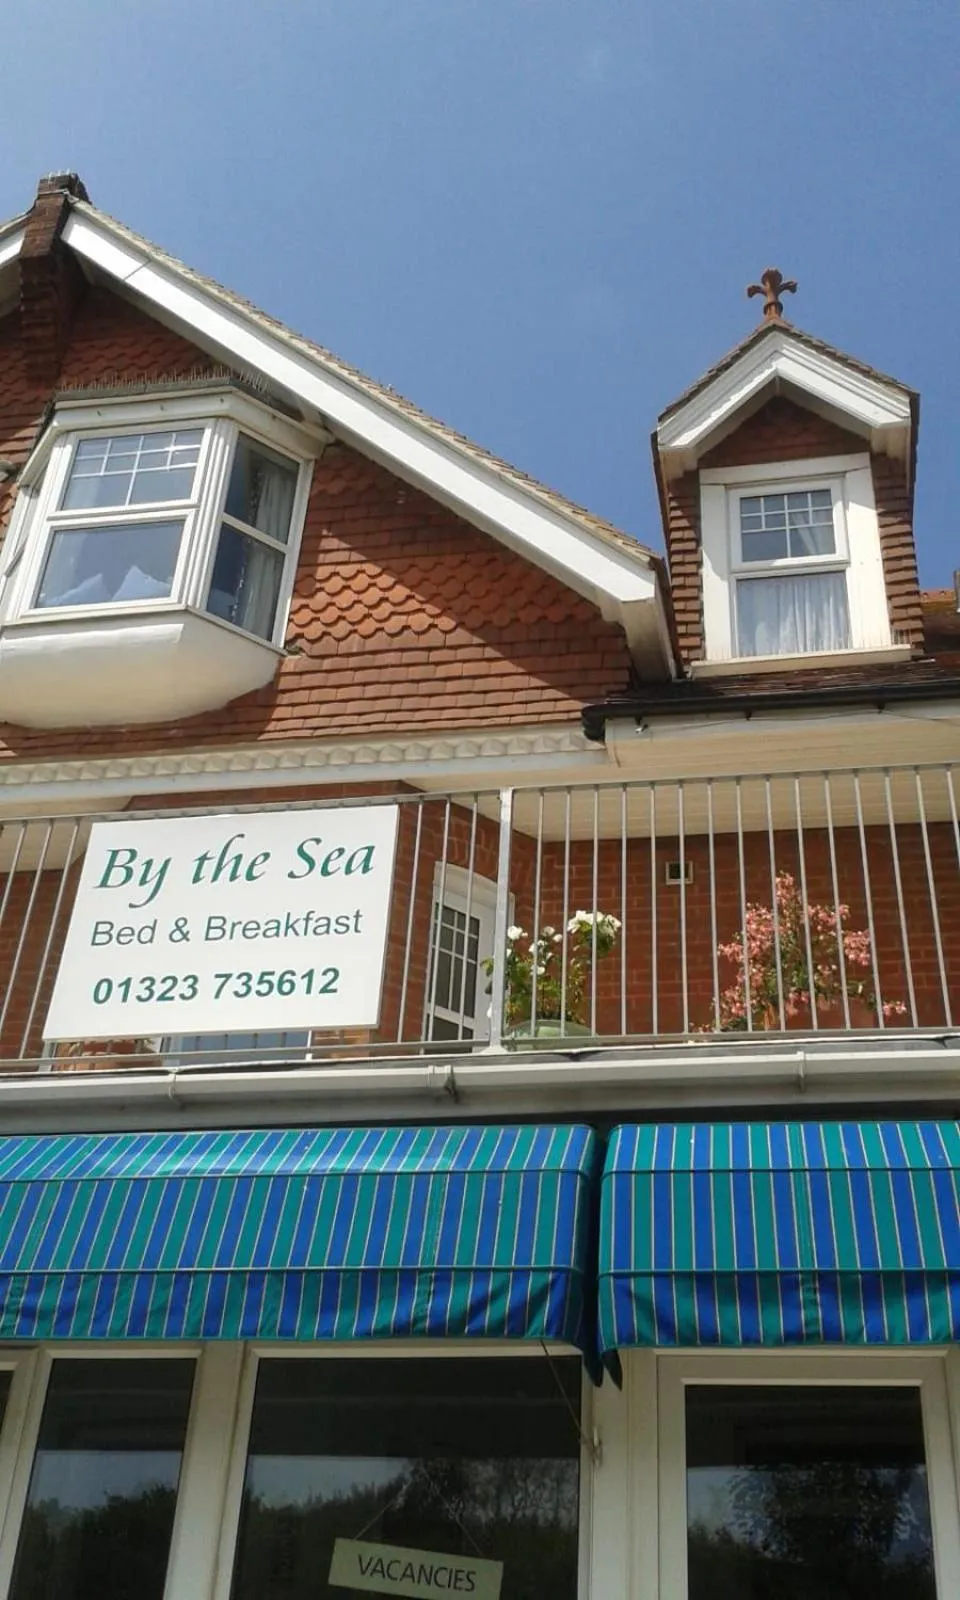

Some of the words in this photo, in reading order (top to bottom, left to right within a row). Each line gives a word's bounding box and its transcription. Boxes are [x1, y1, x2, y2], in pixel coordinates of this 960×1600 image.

[93, 848, 171, 908] By
[191, 833, 271, 885] the
[287, 837, 376, 880] Sea
[90, 918, 157, 946] Bed
[168, 917, 191, 942] &
[204, 909, 363, 941] Breakfast
[92, 974, 199, 1005] 01323
[213, 967, 340, 999] 735612
[358, 1554, 477, 1592] VACANCIES
